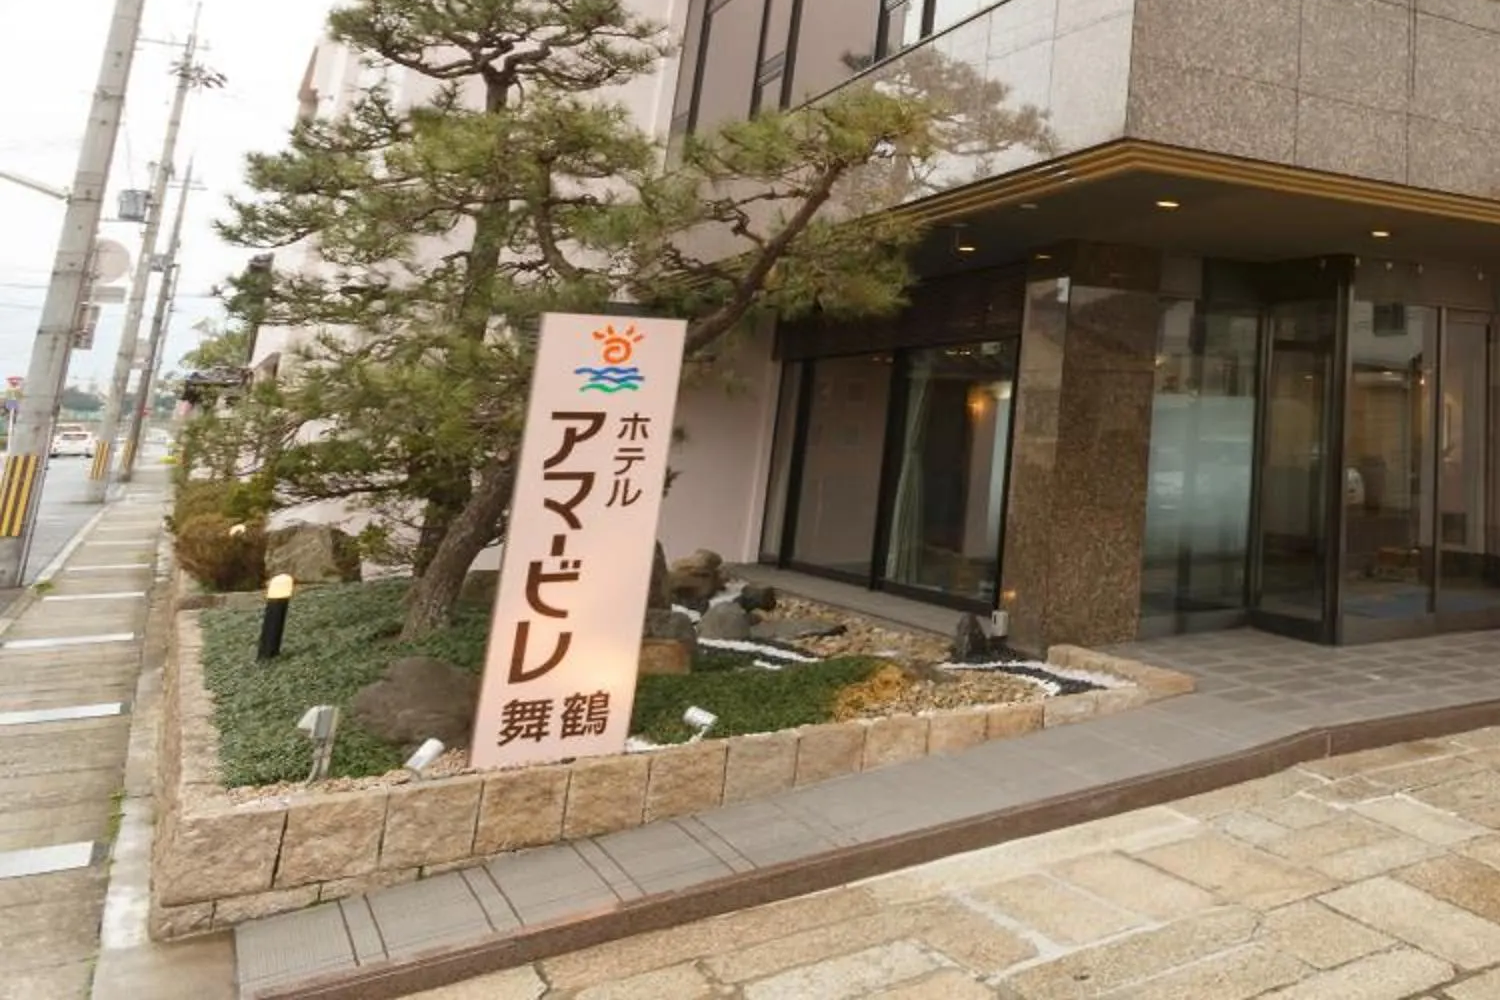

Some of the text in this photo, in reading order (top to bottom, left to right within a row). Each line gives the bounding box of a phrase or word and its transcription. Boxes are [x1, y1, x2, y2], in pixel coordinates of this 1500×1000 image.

[605, 412, 651, 508] ホテル
[507, 411, 606, 684] アマービレ
[497, 690, 611, 747] 舞鶴
